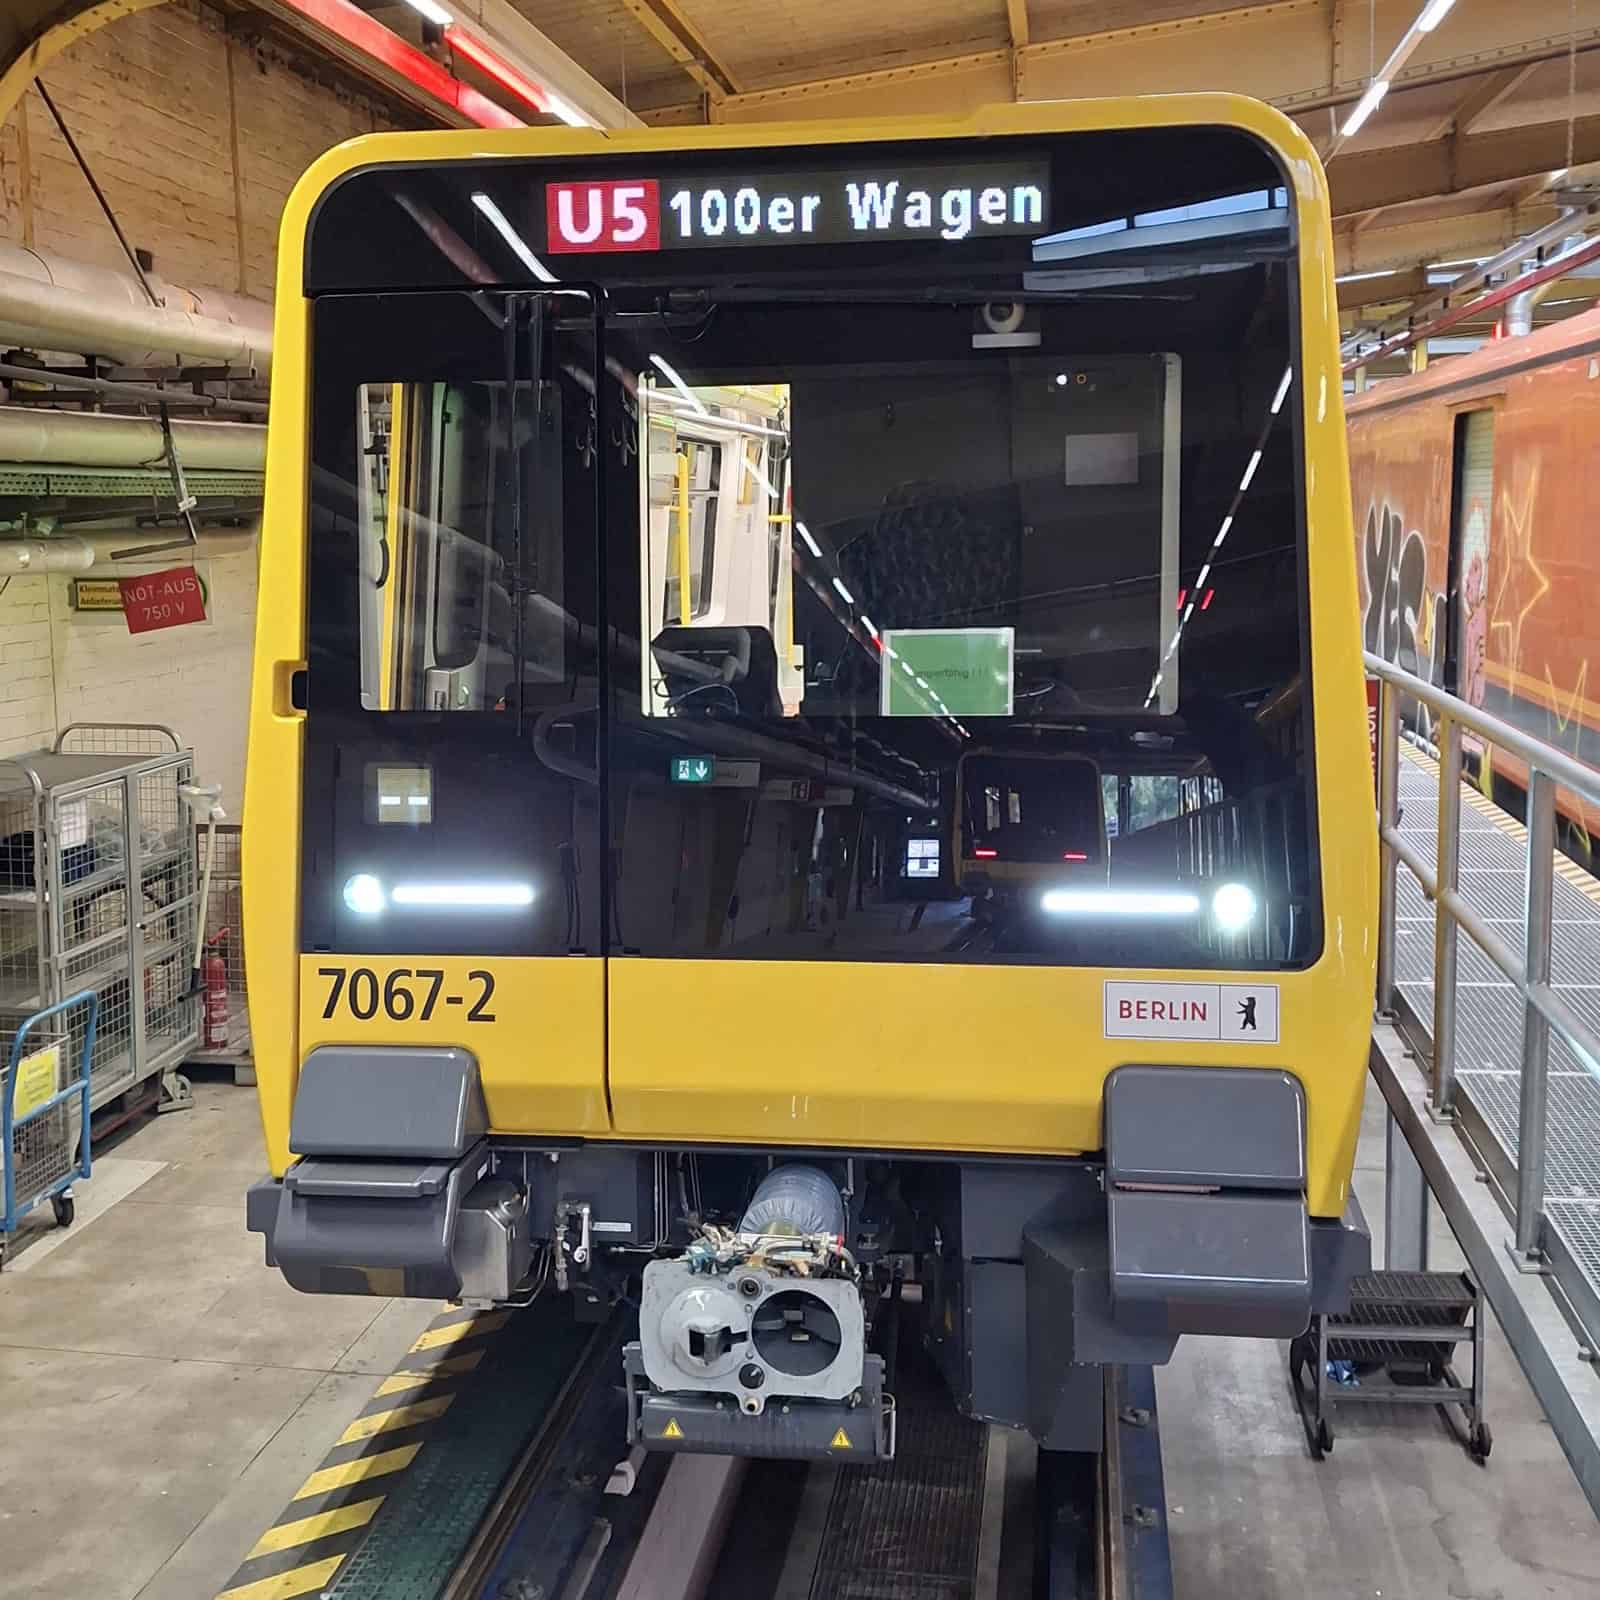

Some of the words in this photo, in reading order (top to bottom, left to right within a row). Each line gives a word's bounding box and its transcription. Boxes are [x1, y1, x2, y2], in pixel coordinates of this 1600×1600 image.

[558, 187, 647, 243] U5
[670, 188, 820, 236] 100er
[846, 182, 1042, 239] Wagen
[125, 577, 196, 603] NOT-AUS
[143, 604, 171, 621] 750
[175, 601, 186, 616] V
[318, 967, 496, 1022] 7067-2
[1119, 999, 1208, 1021] BERLIN
